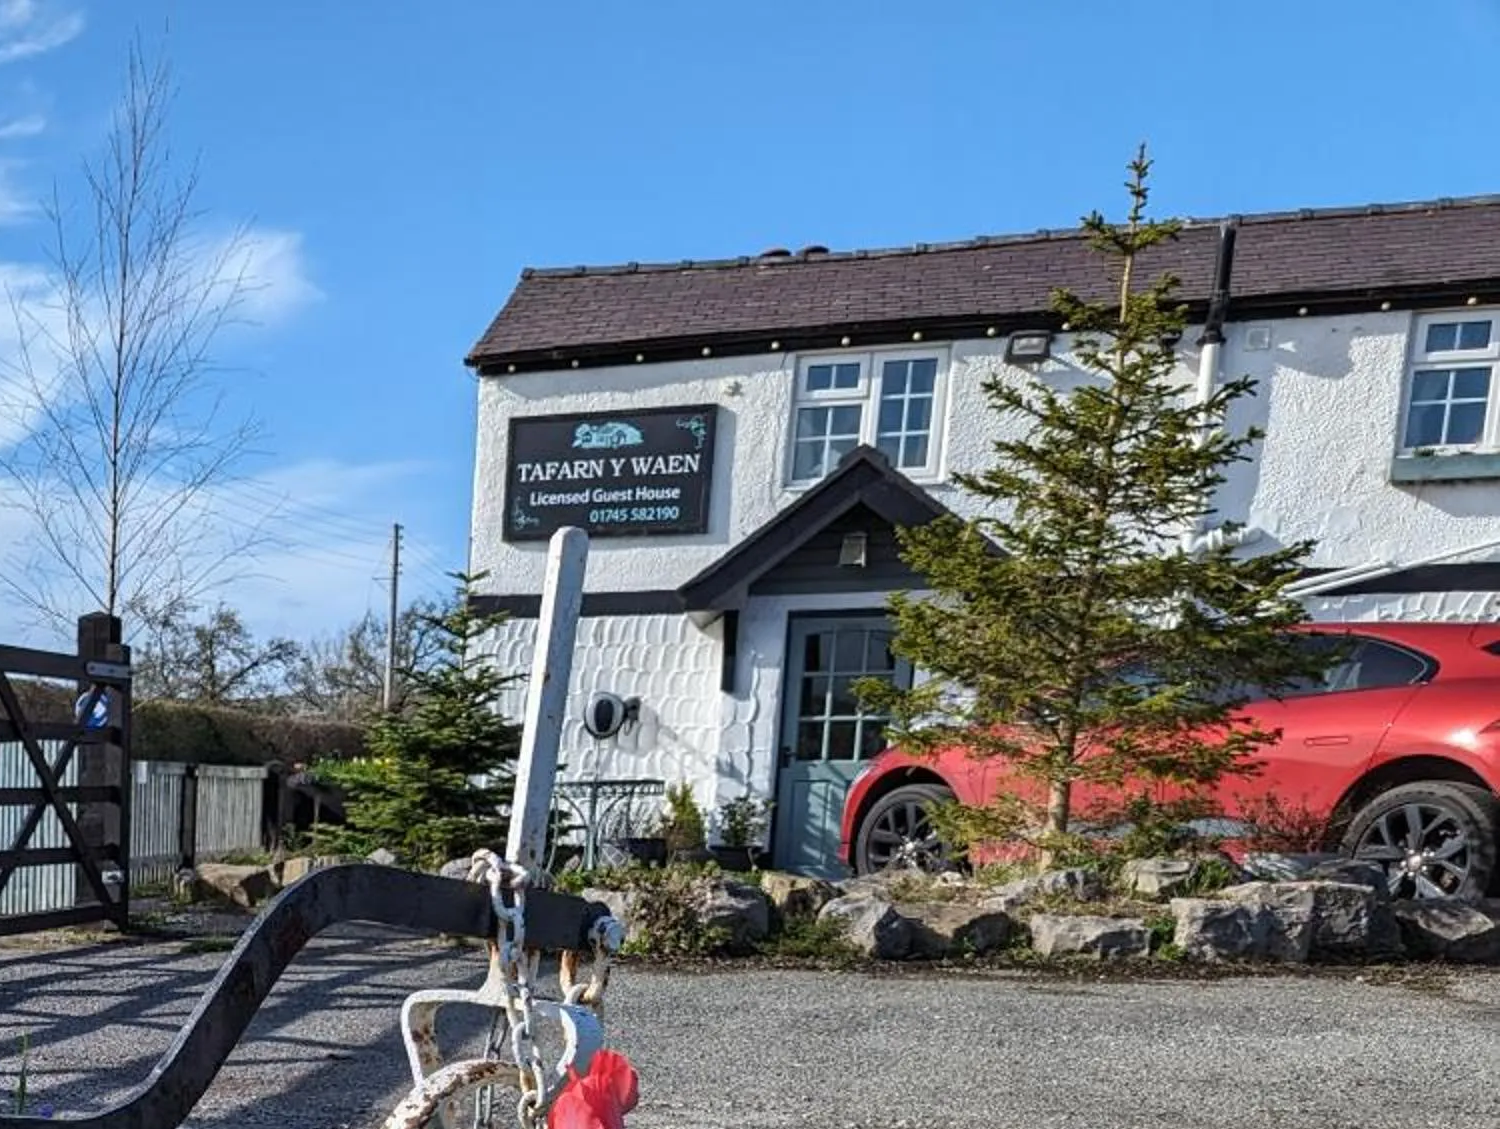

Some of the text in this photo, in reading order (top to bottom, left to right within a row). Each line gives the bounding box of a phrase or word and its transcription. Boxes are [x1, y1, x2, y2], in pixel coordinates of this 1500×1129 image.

[516, 454, 701, 482] TAFARN Y WAEN
[529, 485, 681, 506] Licensed Guest House
[589, 506, 679, 523] 01745 582190
